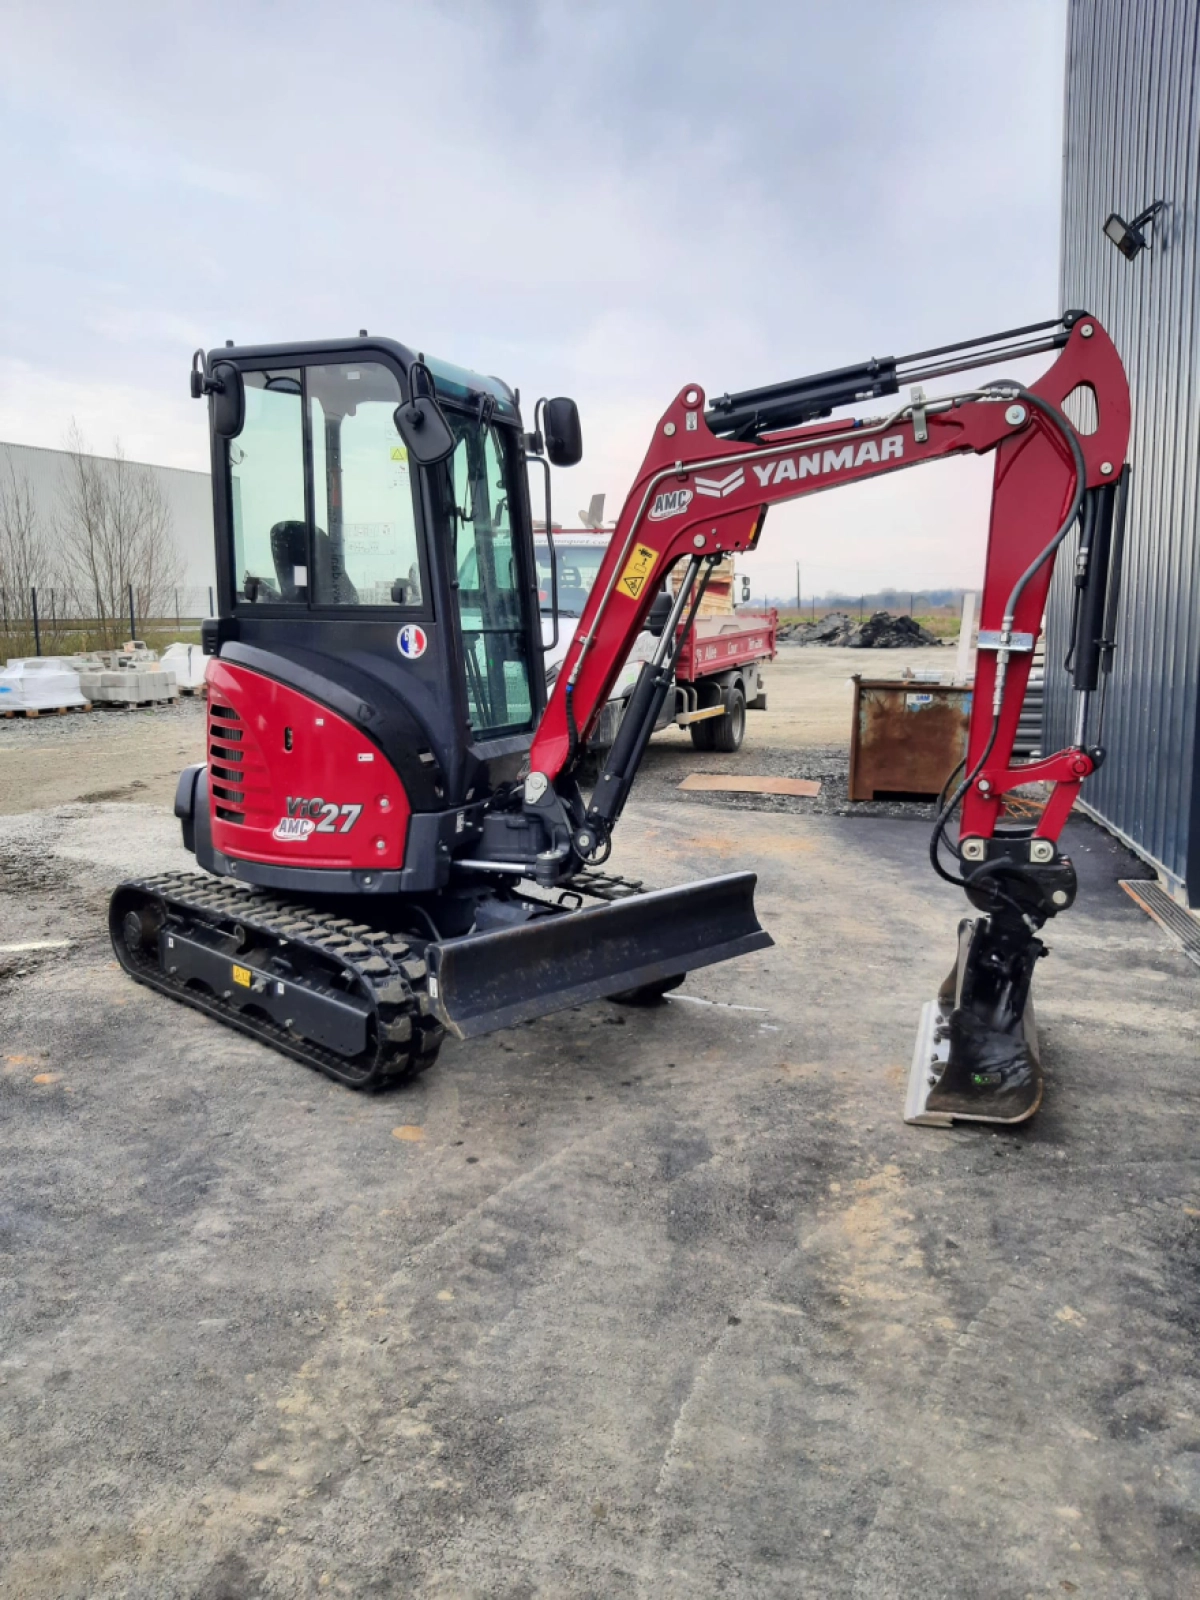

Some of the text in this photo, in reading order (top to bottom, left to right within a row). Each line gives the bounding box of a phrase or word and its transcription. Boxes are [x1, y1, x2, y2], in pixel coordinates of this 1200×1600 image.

[752, 434, 904, 487] YANMAR
[654, 490, 687, 513] AMC
[278, 818, 309, 834] AMC
